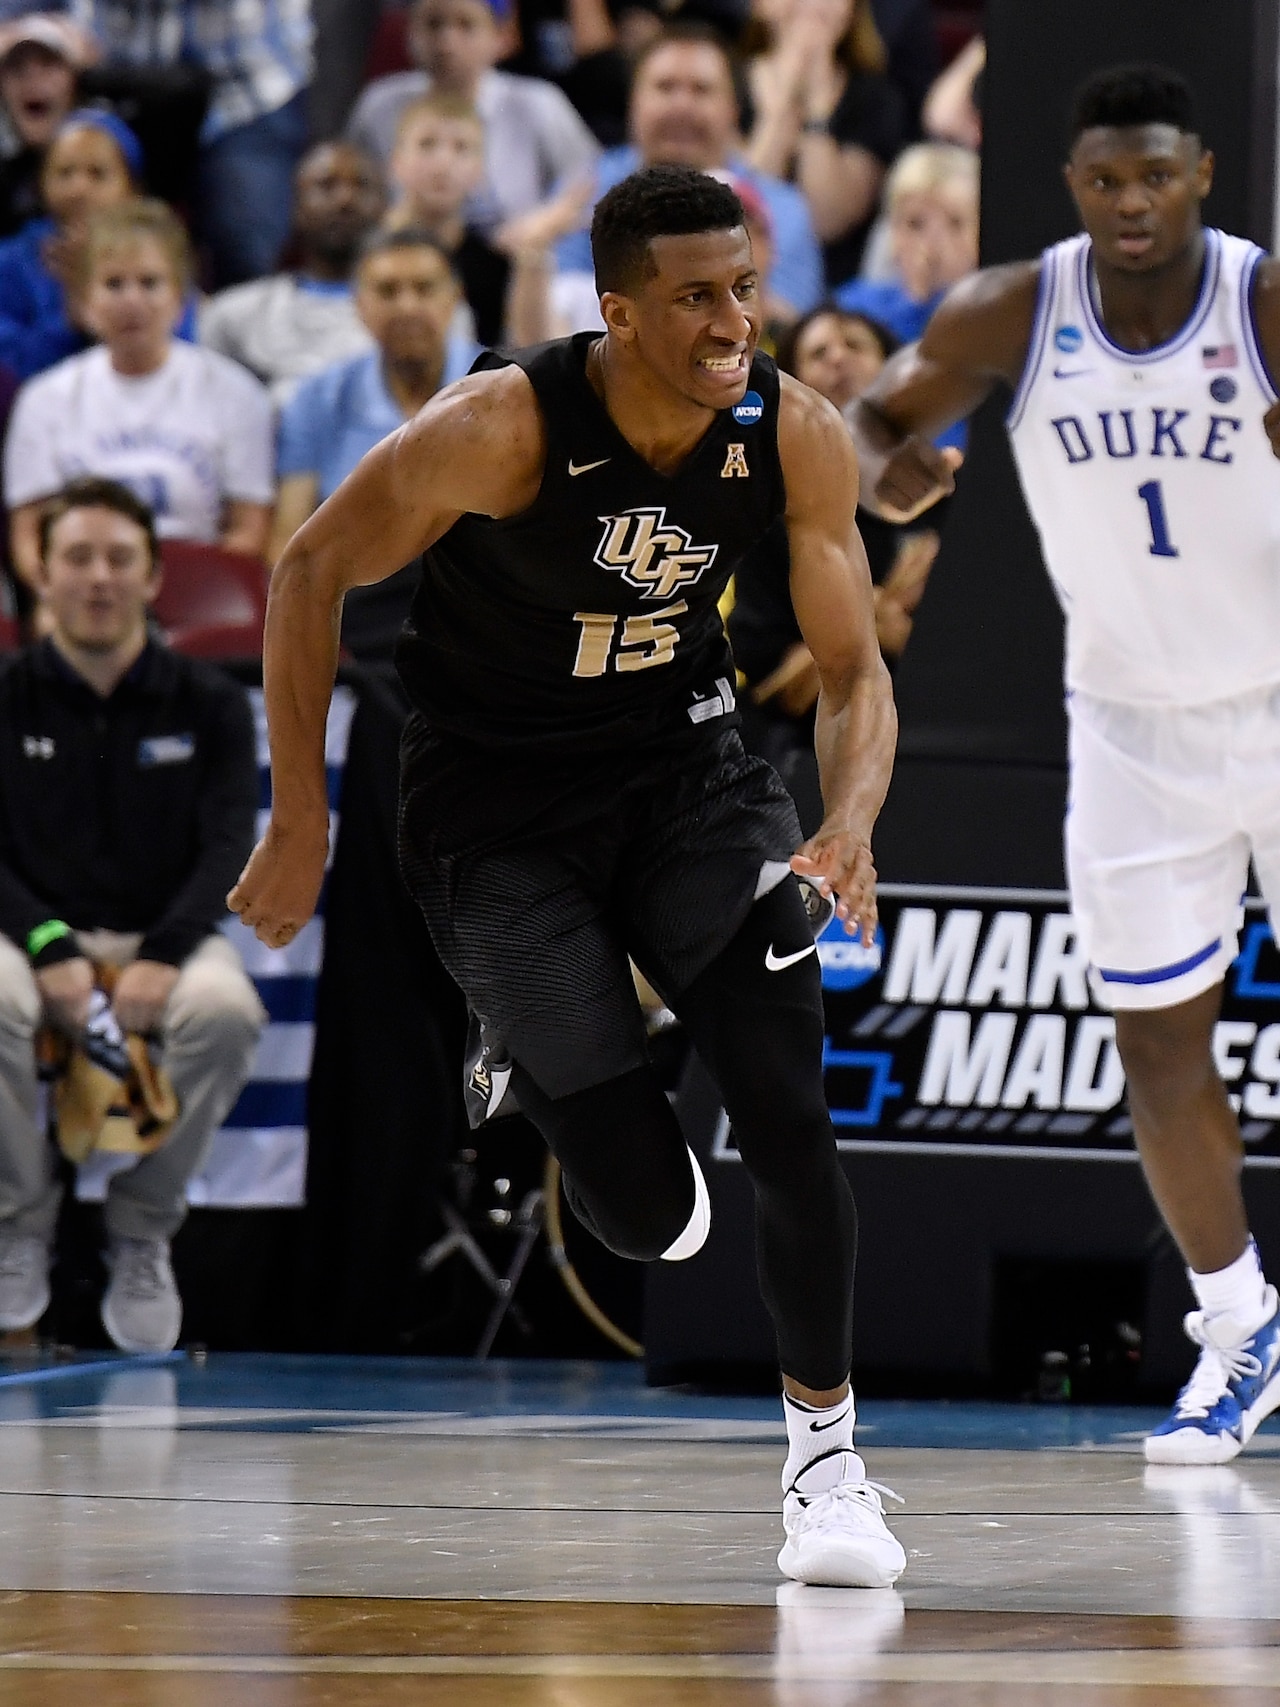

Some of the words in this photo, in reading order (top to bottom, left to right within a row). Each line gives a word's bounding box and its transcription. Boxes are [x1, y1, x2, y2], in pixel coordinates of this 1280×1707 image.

[1051, 408, 1242, 463] DUKE
[599, 512, 713, 597] UCF
[1138, 480, 1179, 557] 1
[572, 599, 689, 677] 15
[884, 907, 1091, 1011] MAR
